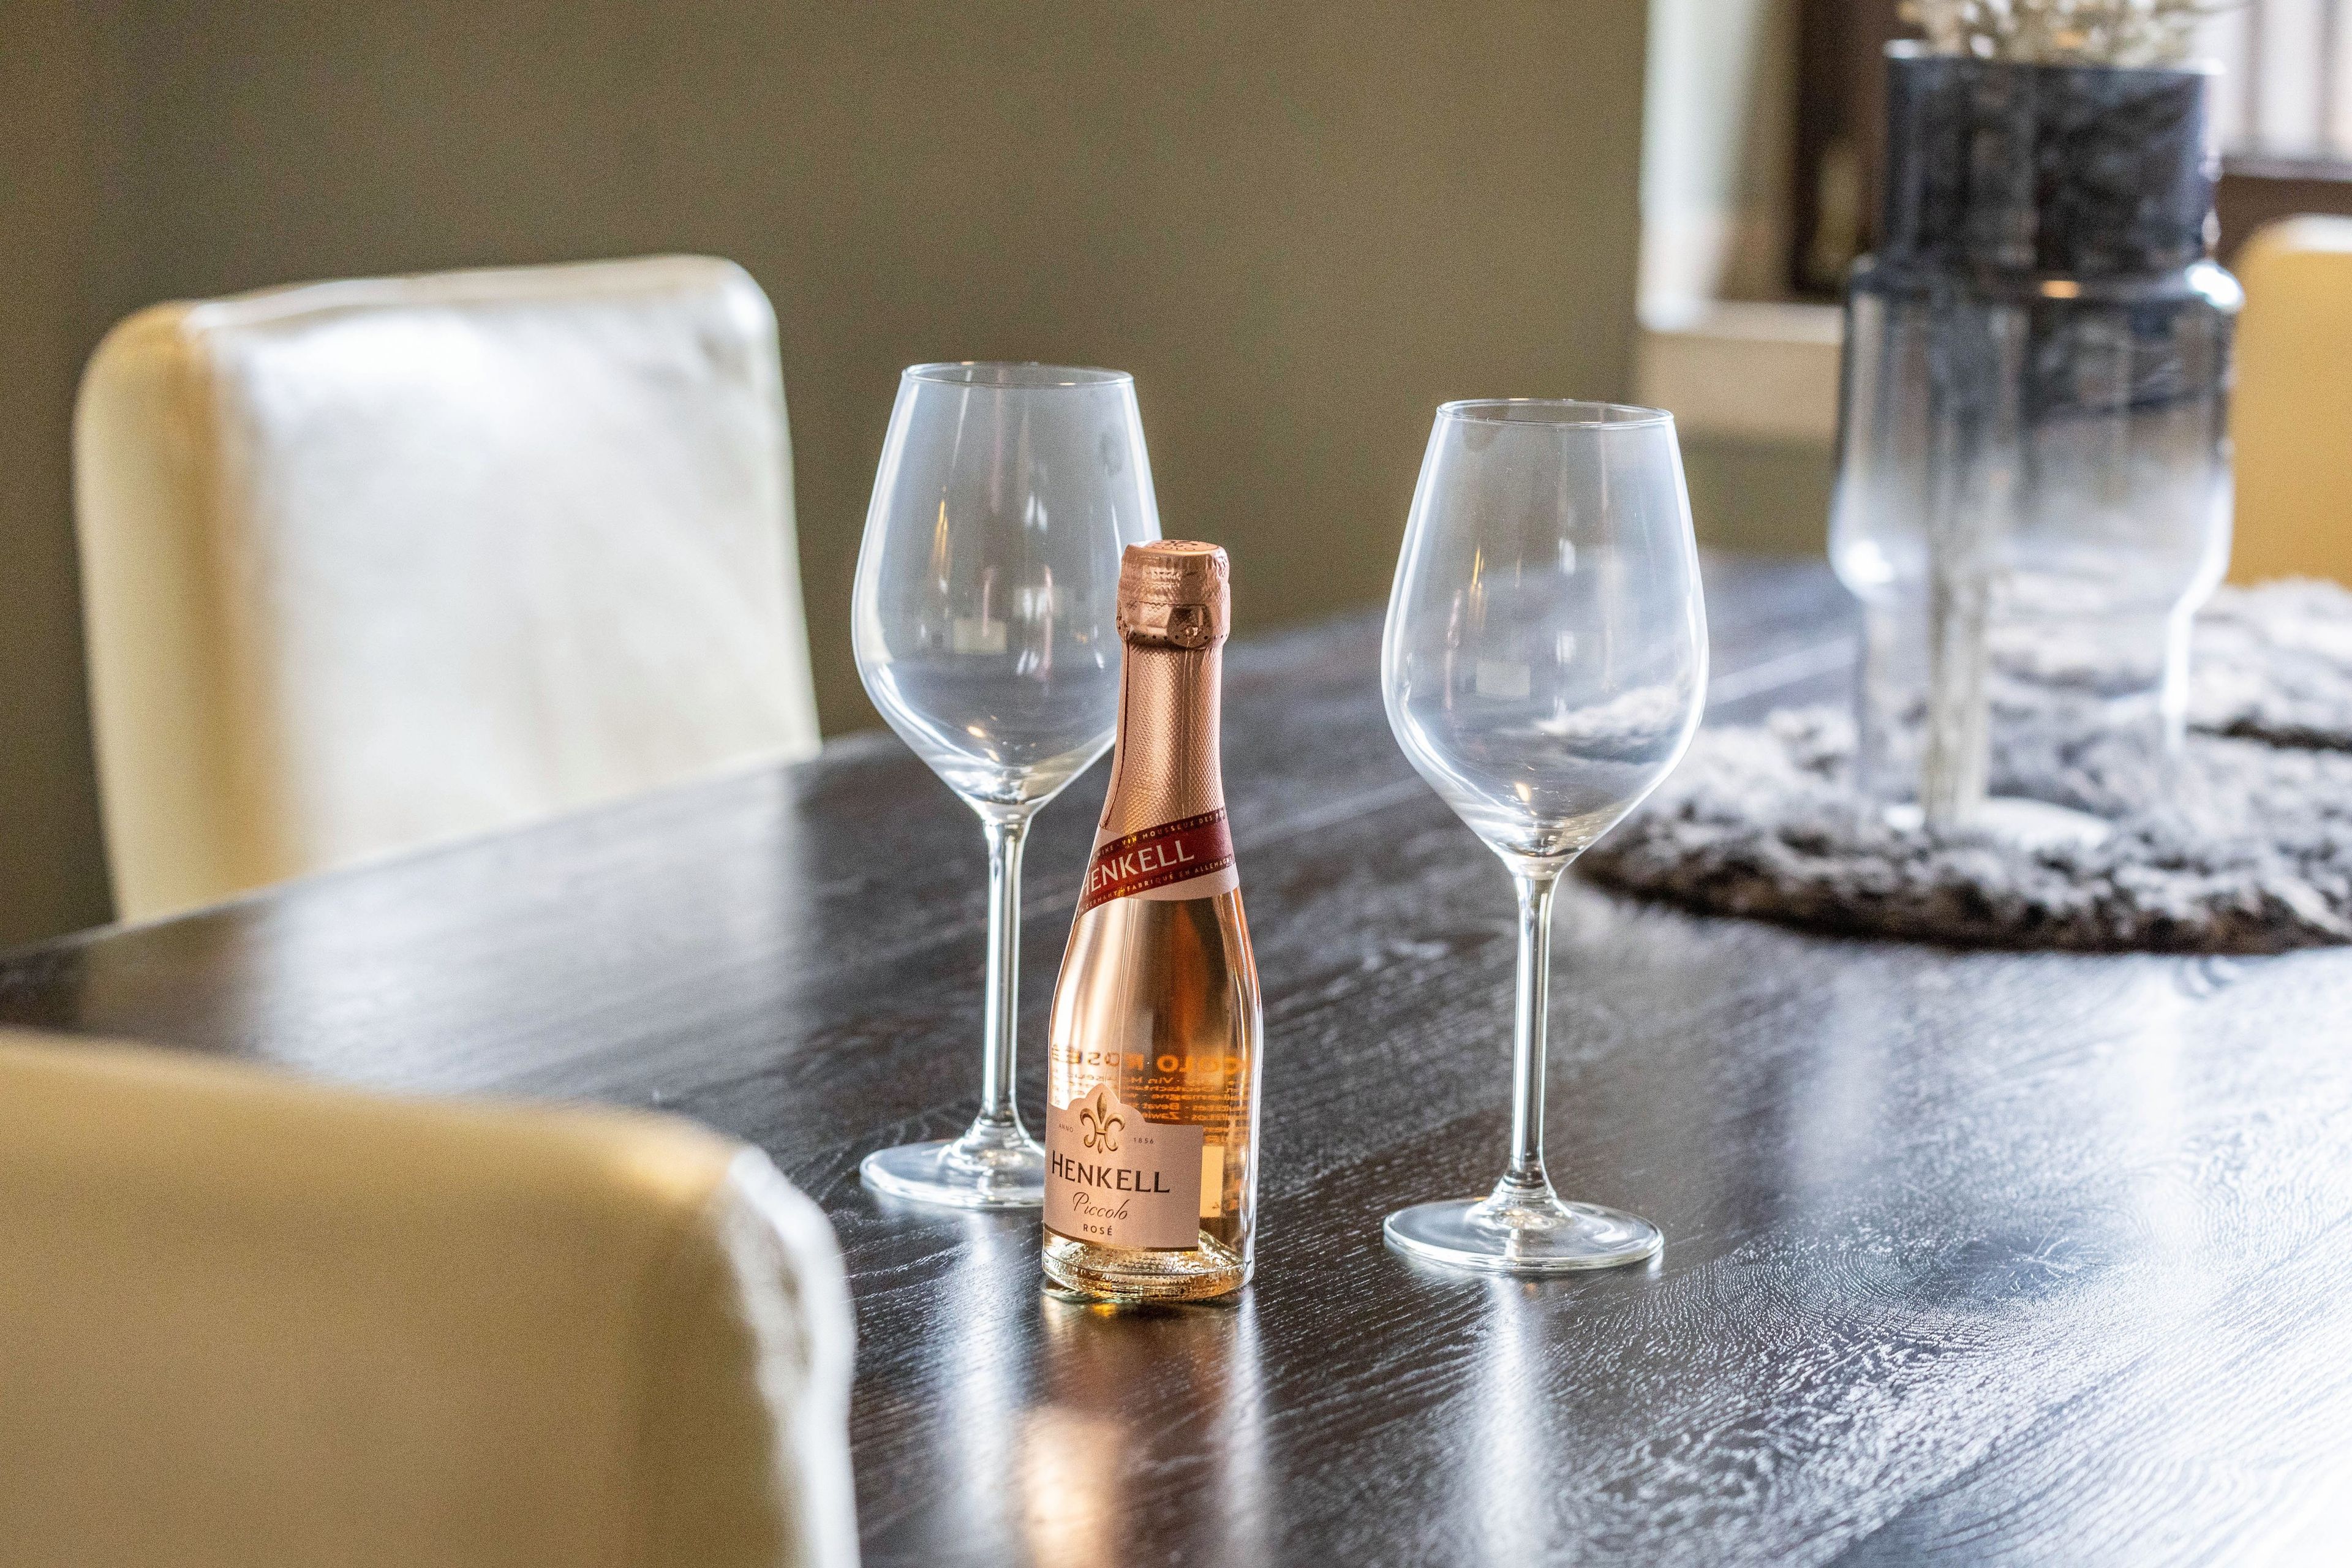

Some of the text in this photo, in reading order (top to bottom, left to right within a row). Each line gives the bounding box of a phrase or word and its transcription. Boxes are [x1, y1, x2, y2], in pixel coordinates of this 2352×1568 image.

[1121, 836, 1137, 846] VIN
[1142, 821, 1194, 840] MOUSSEUX
[1199, 816, 1213, 824] DES
[1058, 1123, 1074, 1133] ANNO
[1052, 1150, 1170, 1193] HENKELL
[1072, 1191, 1131, 1221] Piccolo
[1082, 1223, 1114, 1236] ROSÉ
